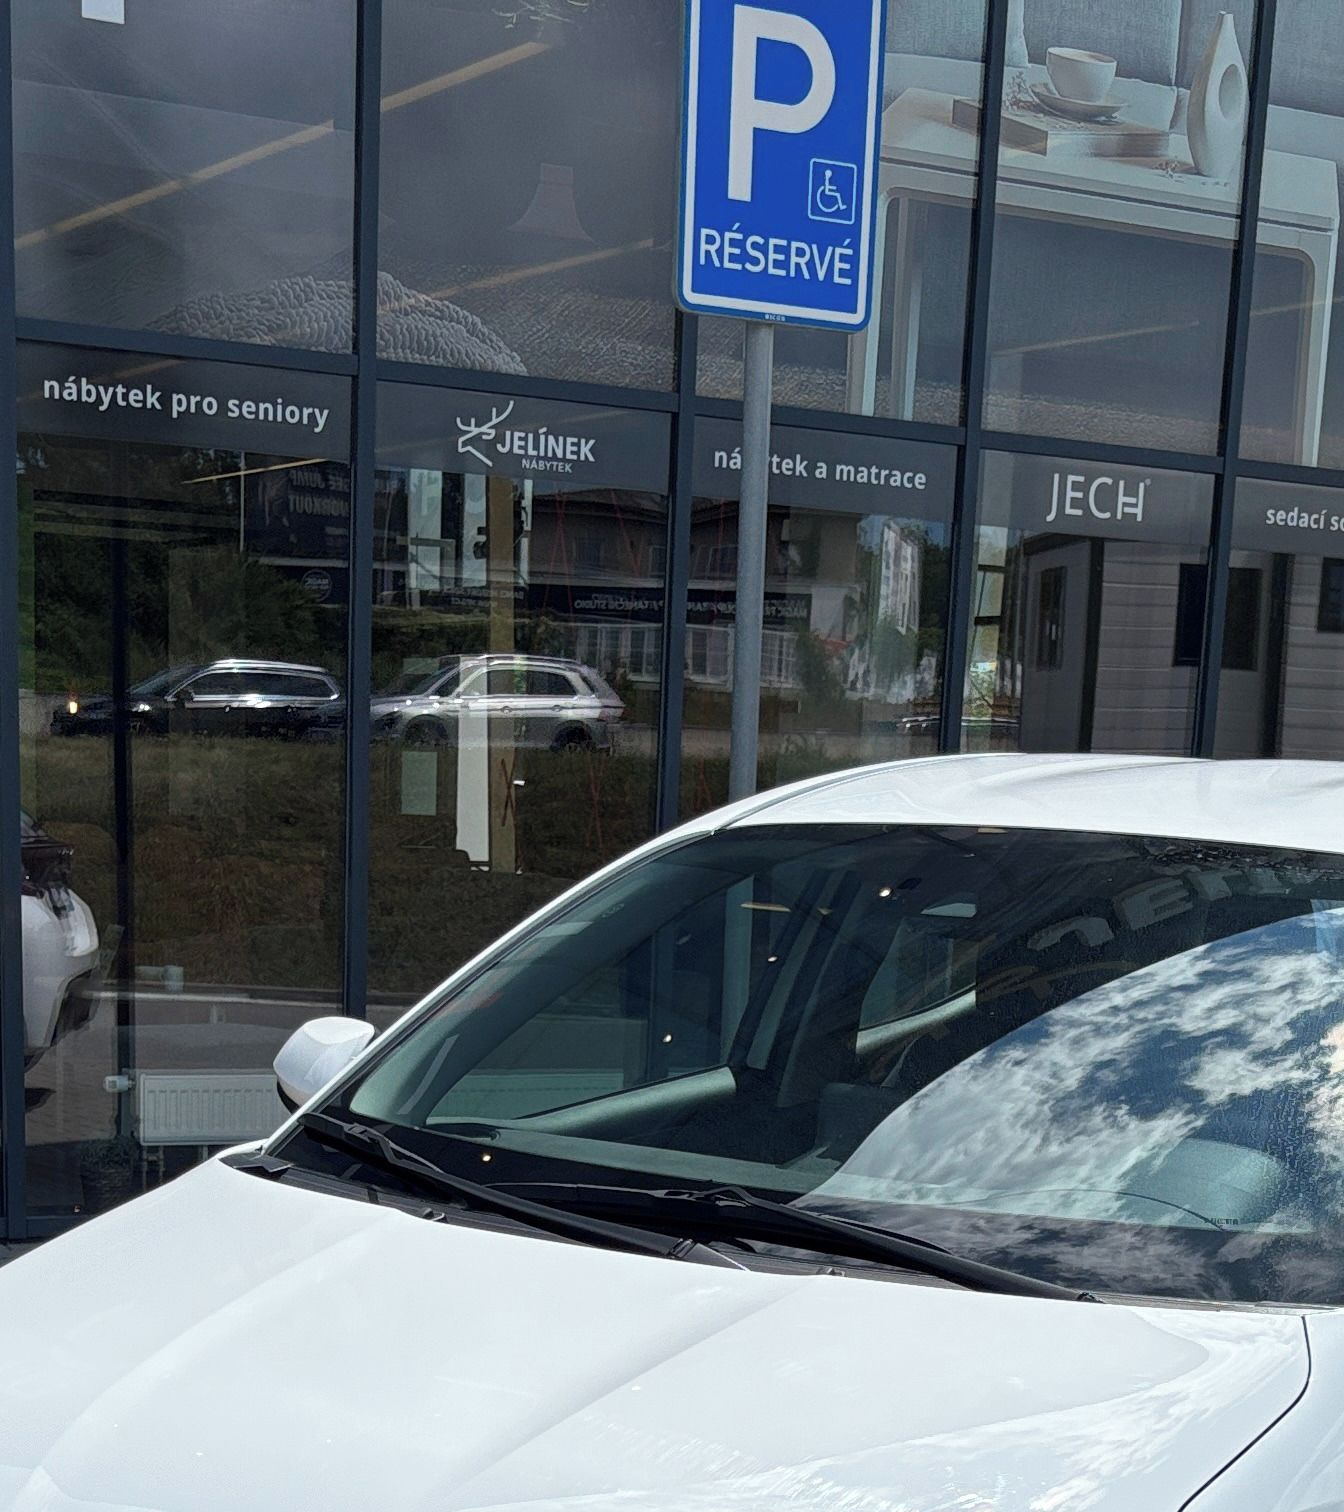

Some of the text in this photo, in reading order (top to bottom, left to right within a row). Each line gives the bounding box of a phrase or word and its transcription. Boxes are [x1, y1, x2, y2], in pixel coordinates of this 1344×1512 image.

[727, 4, 837, 203] P
[699, 222, 854, 286] RÉSERVÉ
[42, 375, 330, 433] nábytek pro seniory
[496, 427, 597, 462] JELÍNEK
[521, 457, 573, 473] NÁBYTEK
[713, 447, 927, 490] nátek a matrace
[1045, 473, 1145, 522] JECH
[1265, 506, 1328, 530] sedací
